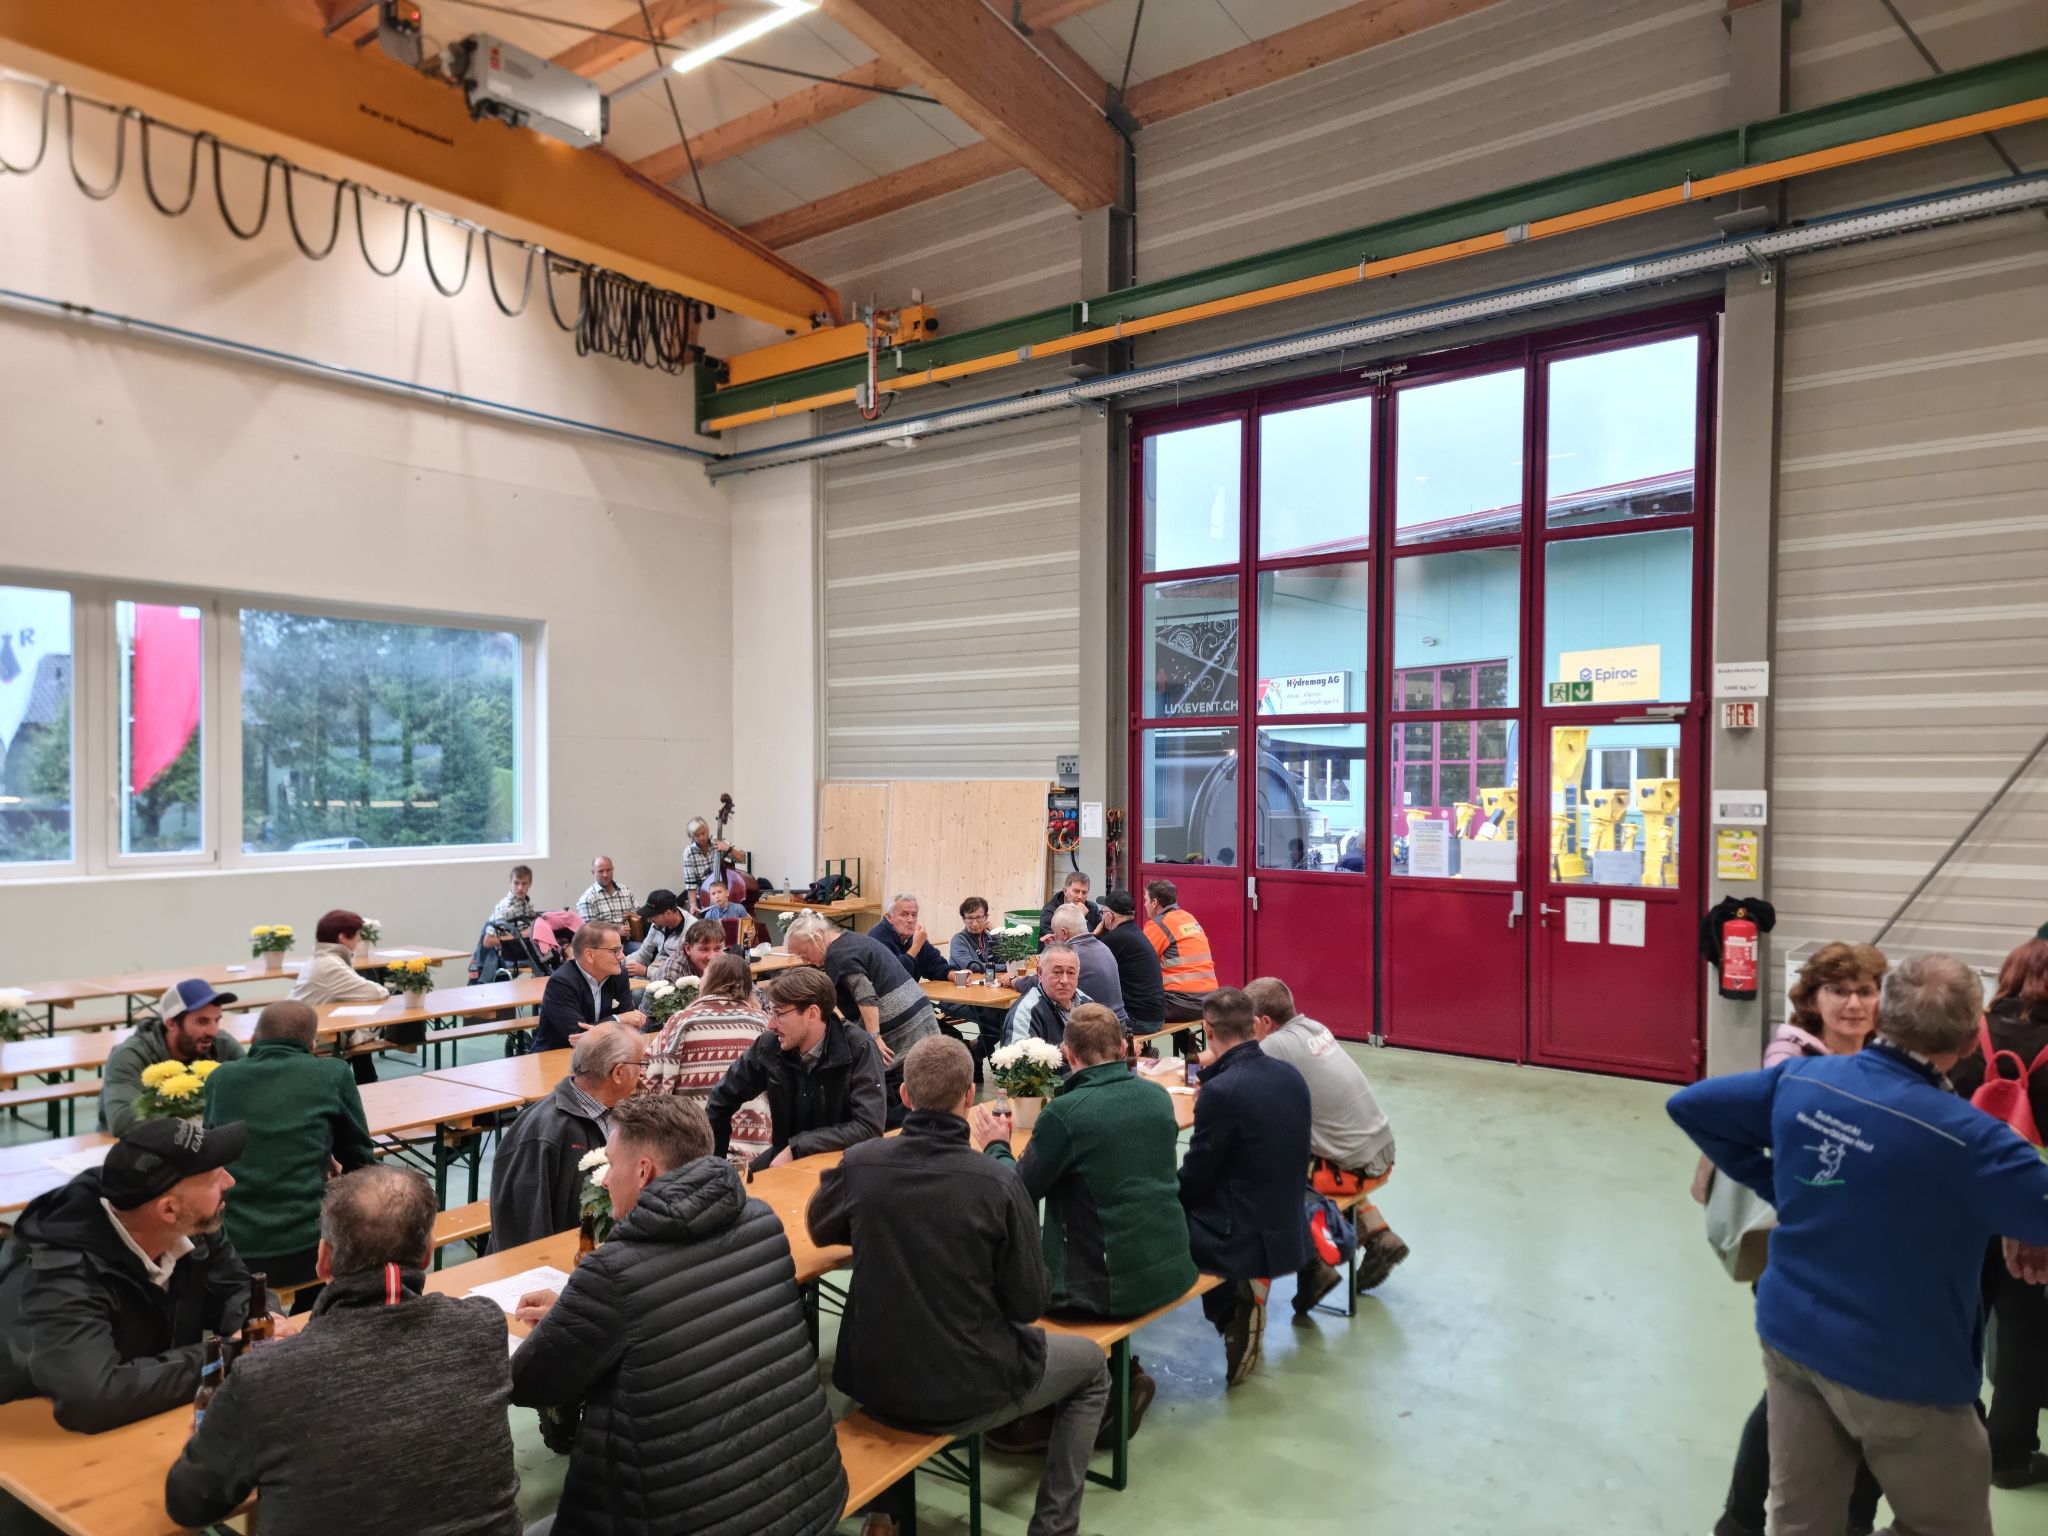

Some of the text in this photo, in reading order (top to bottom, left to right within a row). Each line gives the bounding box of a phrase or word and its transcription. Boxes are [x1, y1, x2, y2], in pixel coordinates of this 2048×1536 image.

[1286, 675, 1340, 689] Hydremag AG
[1595, 667, 1638, 683] Epiroc
[1164, 700, 1238, 715] LUXEVENT.CH
